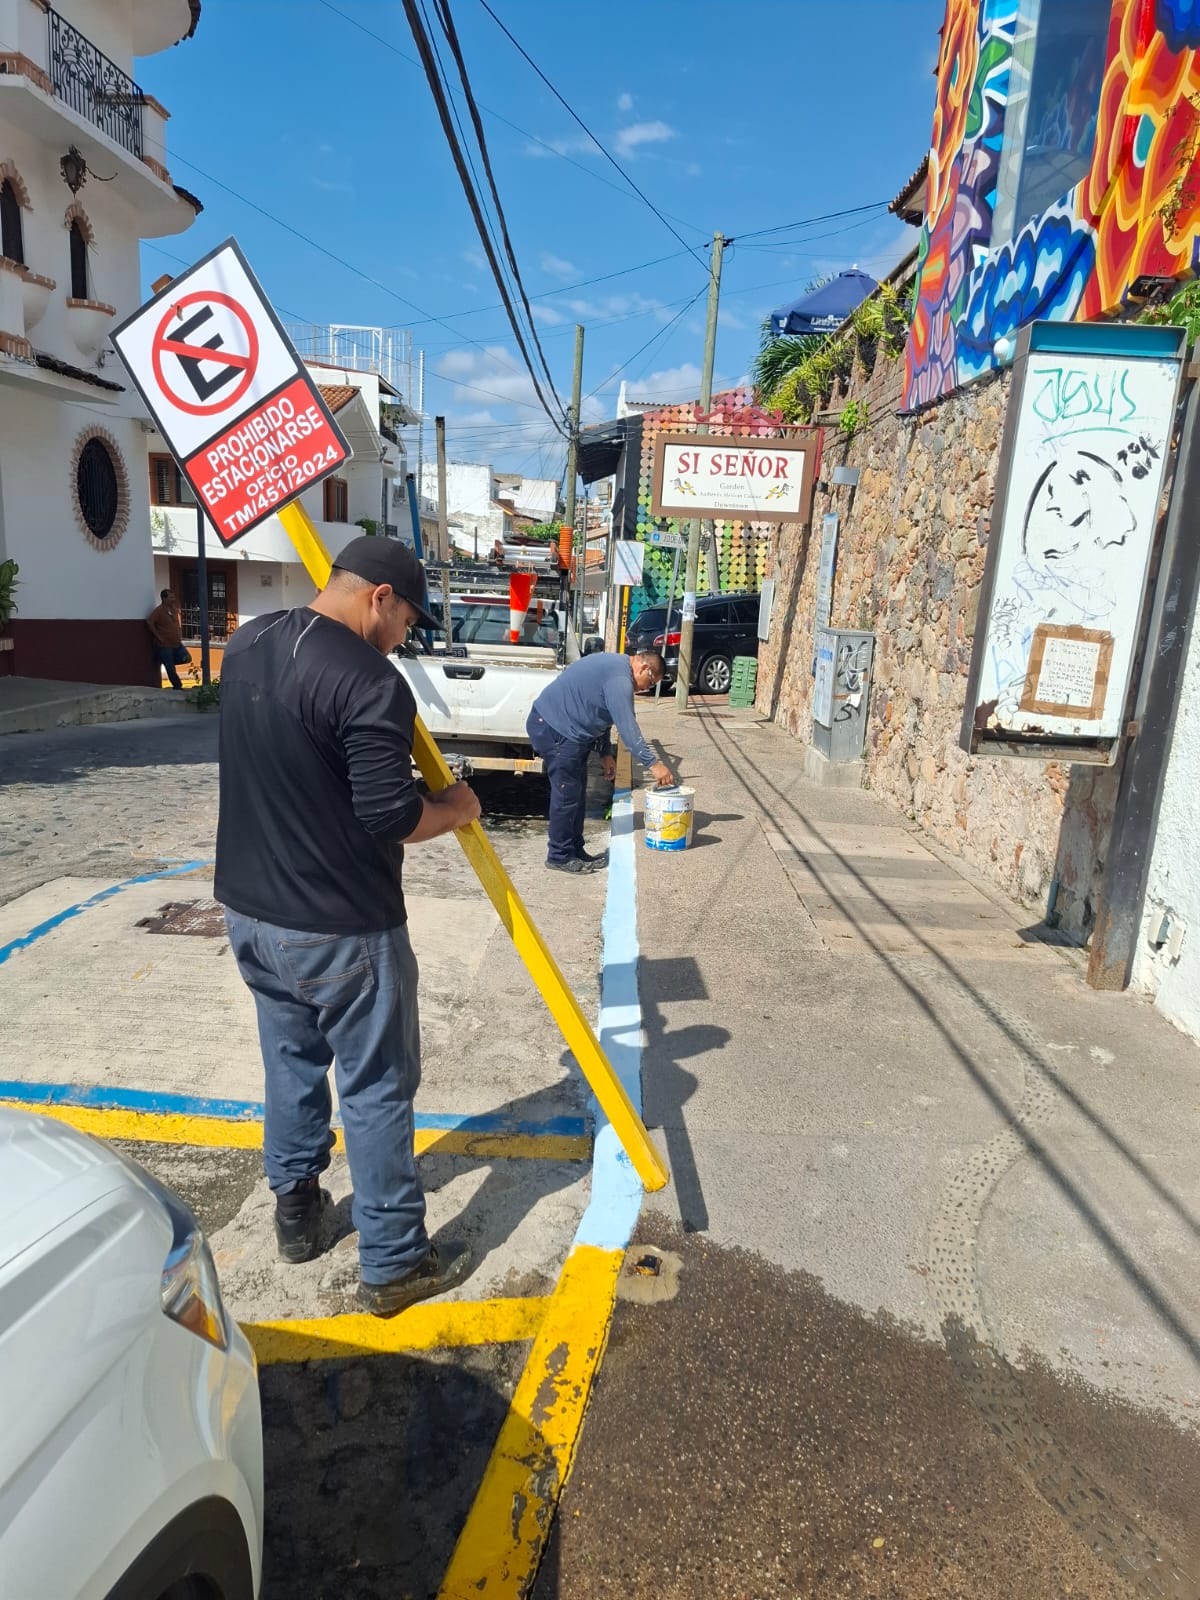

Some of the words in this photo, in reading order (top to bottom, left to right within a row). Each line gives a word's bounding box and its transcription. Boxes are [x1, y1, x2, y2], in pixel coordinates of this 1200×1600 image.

[201, 406, 323, 506] ESTACIONARSE
[207, 397, 294, 473] PROHIBIDO
[246, 455, 298, 497] OFICIO
[678, 452, 700, 474] SI
[710, 450, 788, 479] SEÑOR
[223, 444, 338, 532] TM/451/2024
[714, 501, 749, 509] Downtown
[719, 482, 745, 490] Garden
